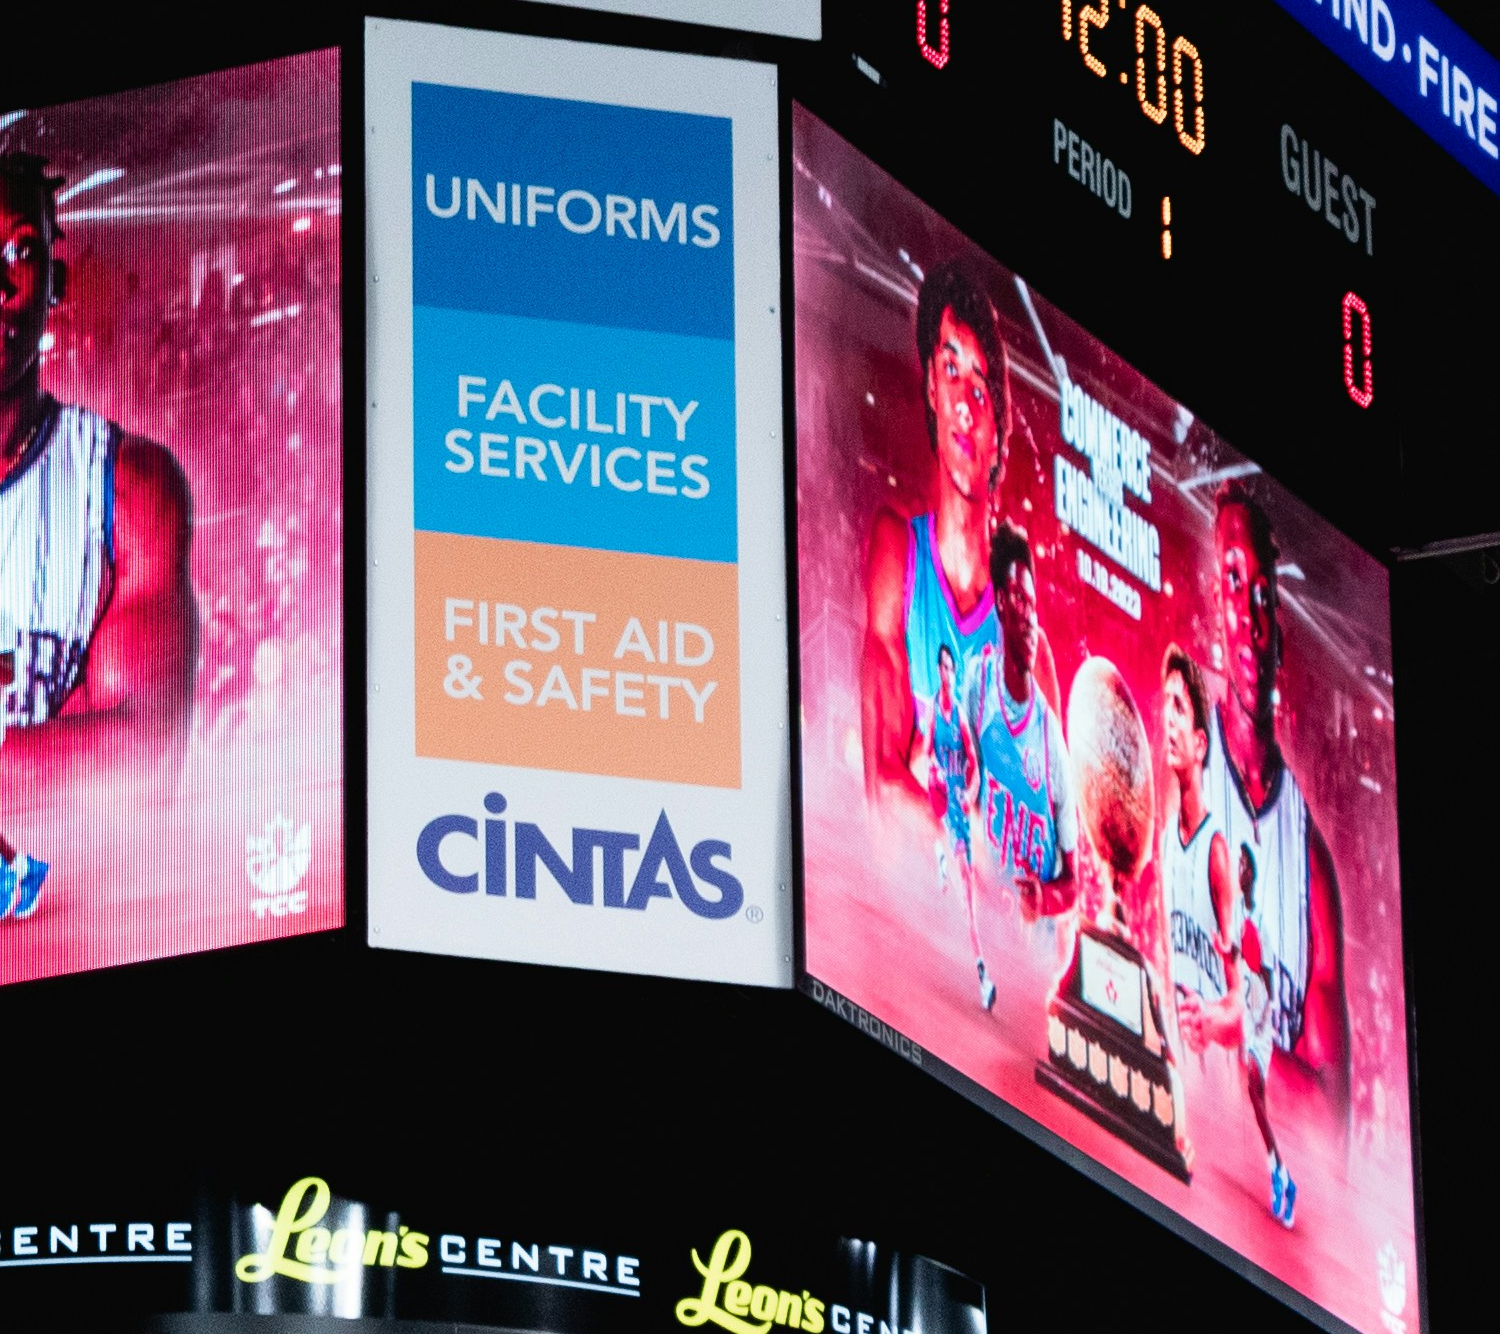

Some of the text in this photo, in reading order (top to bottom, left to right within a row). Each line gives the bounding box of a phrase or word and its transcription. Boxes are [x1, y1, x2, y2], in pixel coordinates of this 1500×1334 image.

[1418, 35, 1500, 160] FIRE
[426, 173, 721, 249] UNIFORMS
[1053, 117, 1132, 220] PERIOD
[1280, 123, 1376, 257] GUEST
[1162, 195, 1172, 259] 1
[1342, 291, 1373, 409] 0
[458, 373, 699, 442] FACILITY
[1060, 378, 1152, 505] COMMERCE
[445, 428, 711, 500] SERVICES
[1054, 453, 1161, 593] ENGINEERING
[445, 597, 716, 668] FIRST AID
[443, 654, 718, 724] & SAFETY
[812, 979, 923, 1067] DAKTRONICS
[235, 1176, 641, 1287] Leon's CENTRE
